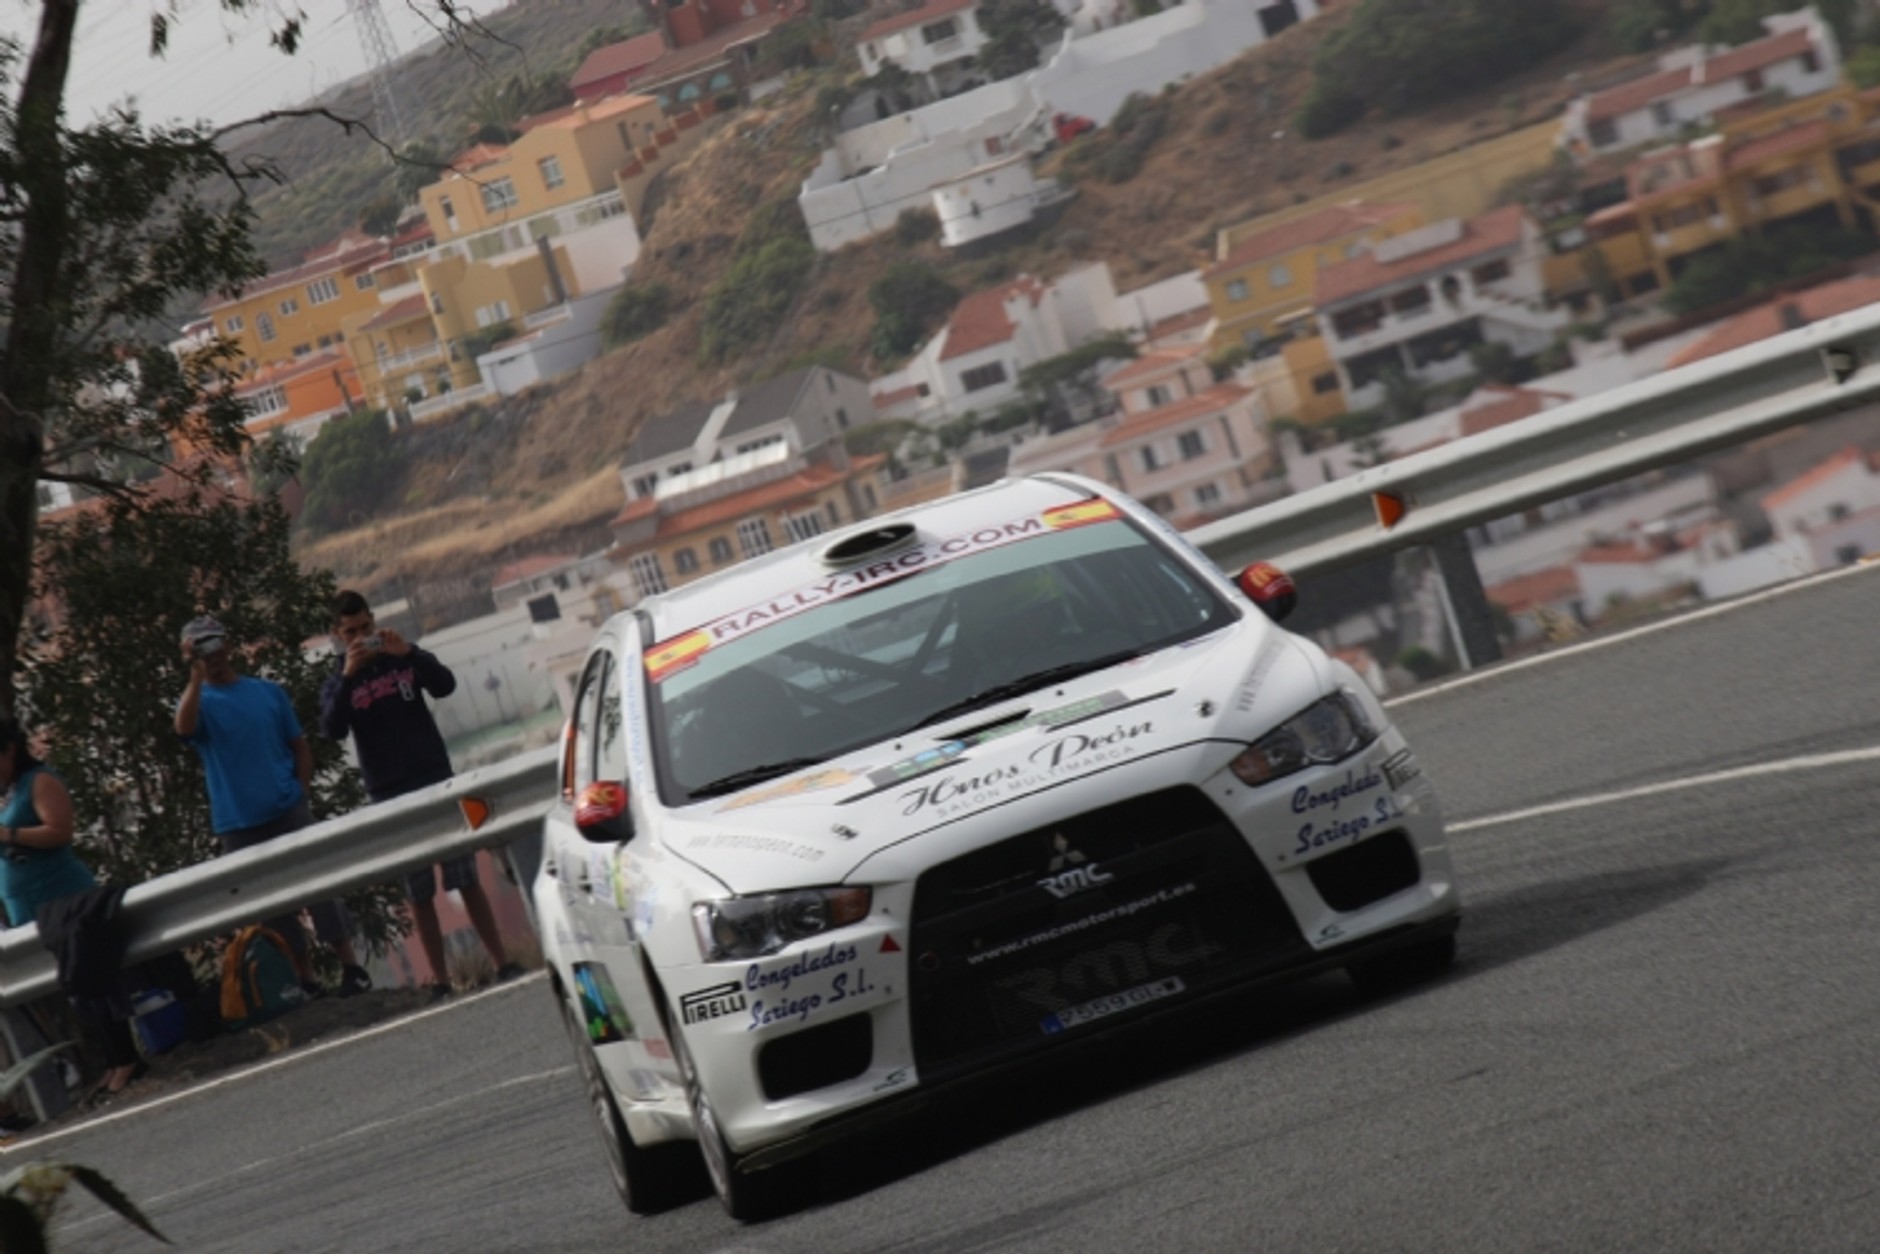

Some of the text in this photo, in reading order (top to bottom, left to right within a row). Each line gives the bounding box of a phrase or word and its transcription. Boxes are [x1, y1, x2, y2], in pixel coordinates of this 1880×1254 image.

[711, 517, 1042, 639] RALLY-IRC.COM
[967, 882, 1196, 965] www.rmcmotorsport.es
[745, 942, 857, 992] Congelados
[679, 980, 747, 1025] PIRELLI
